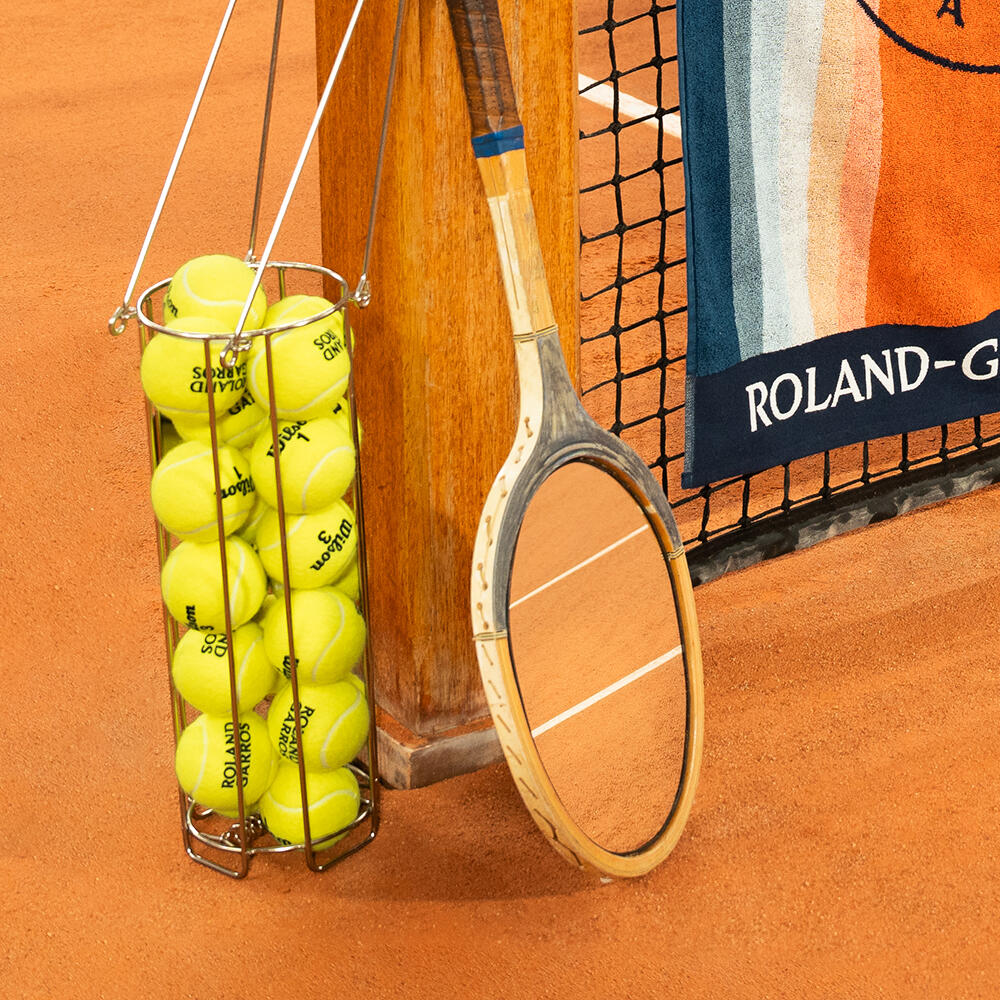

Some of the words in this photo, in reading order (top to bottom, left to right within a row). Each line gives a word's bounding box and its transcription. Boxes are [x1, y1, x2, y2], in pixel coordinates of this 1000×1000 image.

[310, 519, 352, 570] Wilson
[318, 531, 331, 544] 3
[221, 722, 237, 788] ROLAND
